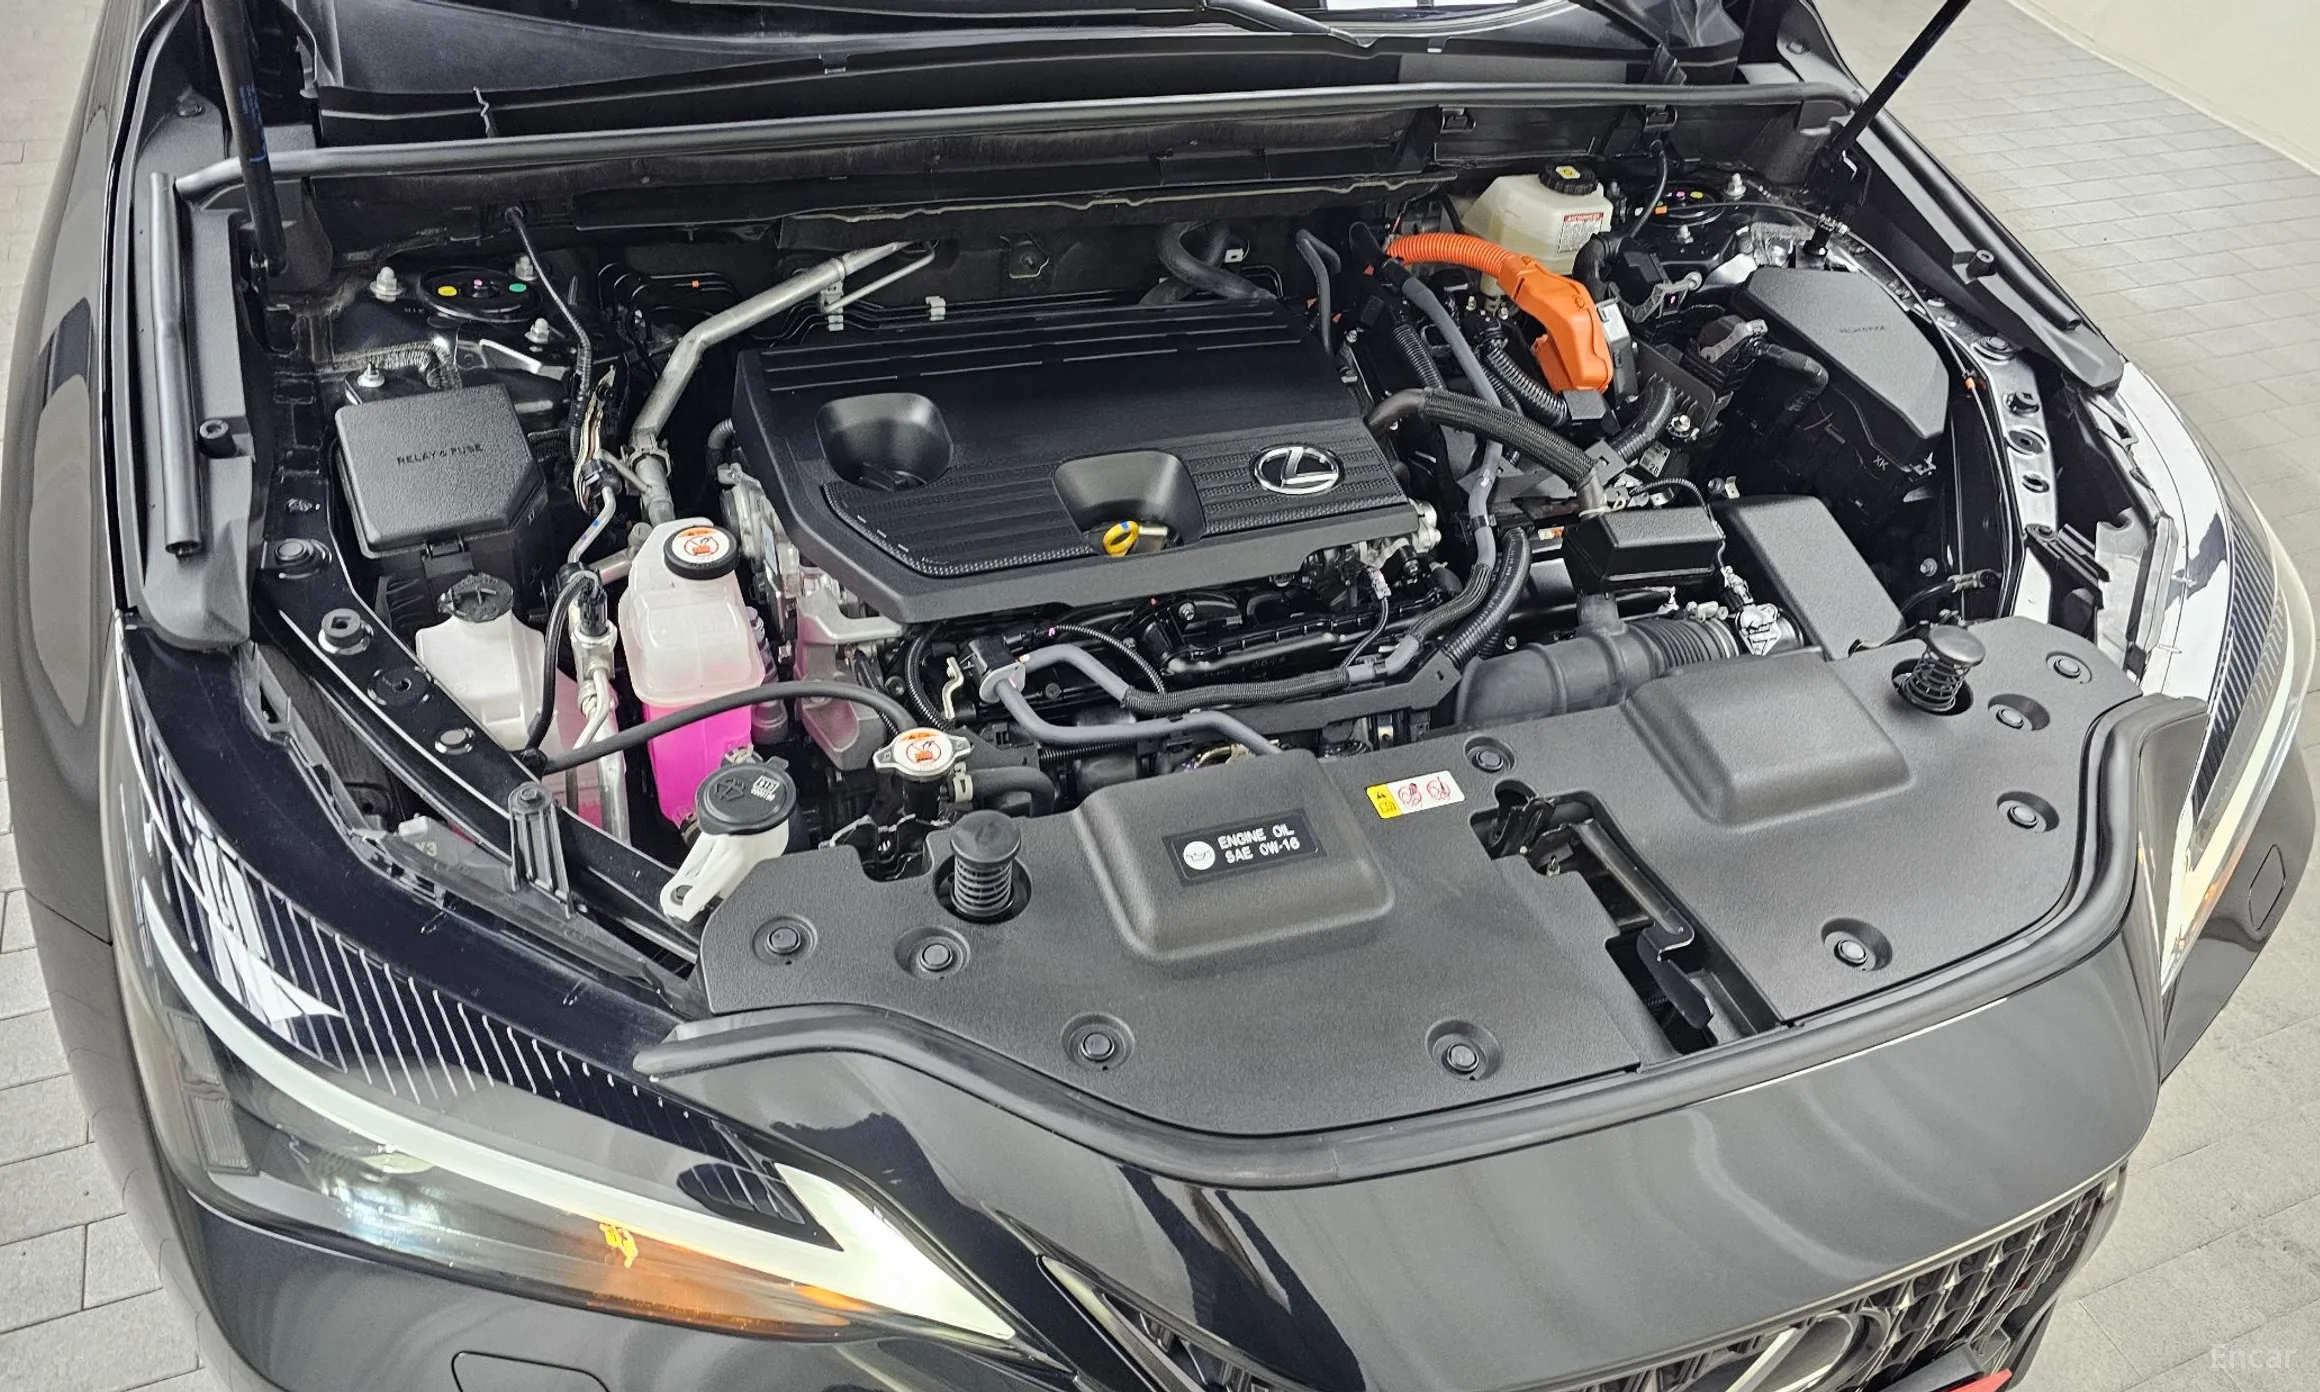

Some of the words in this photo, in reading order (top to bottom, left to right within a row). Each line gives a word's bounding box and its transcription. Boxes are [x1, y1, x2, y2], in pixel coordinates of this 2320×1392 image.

[397, 450, 436, 465] RELAY
[451, 444, 484, 456] FUSE
[1218, 828, 1266, 849] ENGINE
[1272, 824, 1295, 838] OIL
[1225, 846, 1253, 864] SAE
[1259, 837, 1300, 856] 0W-16
